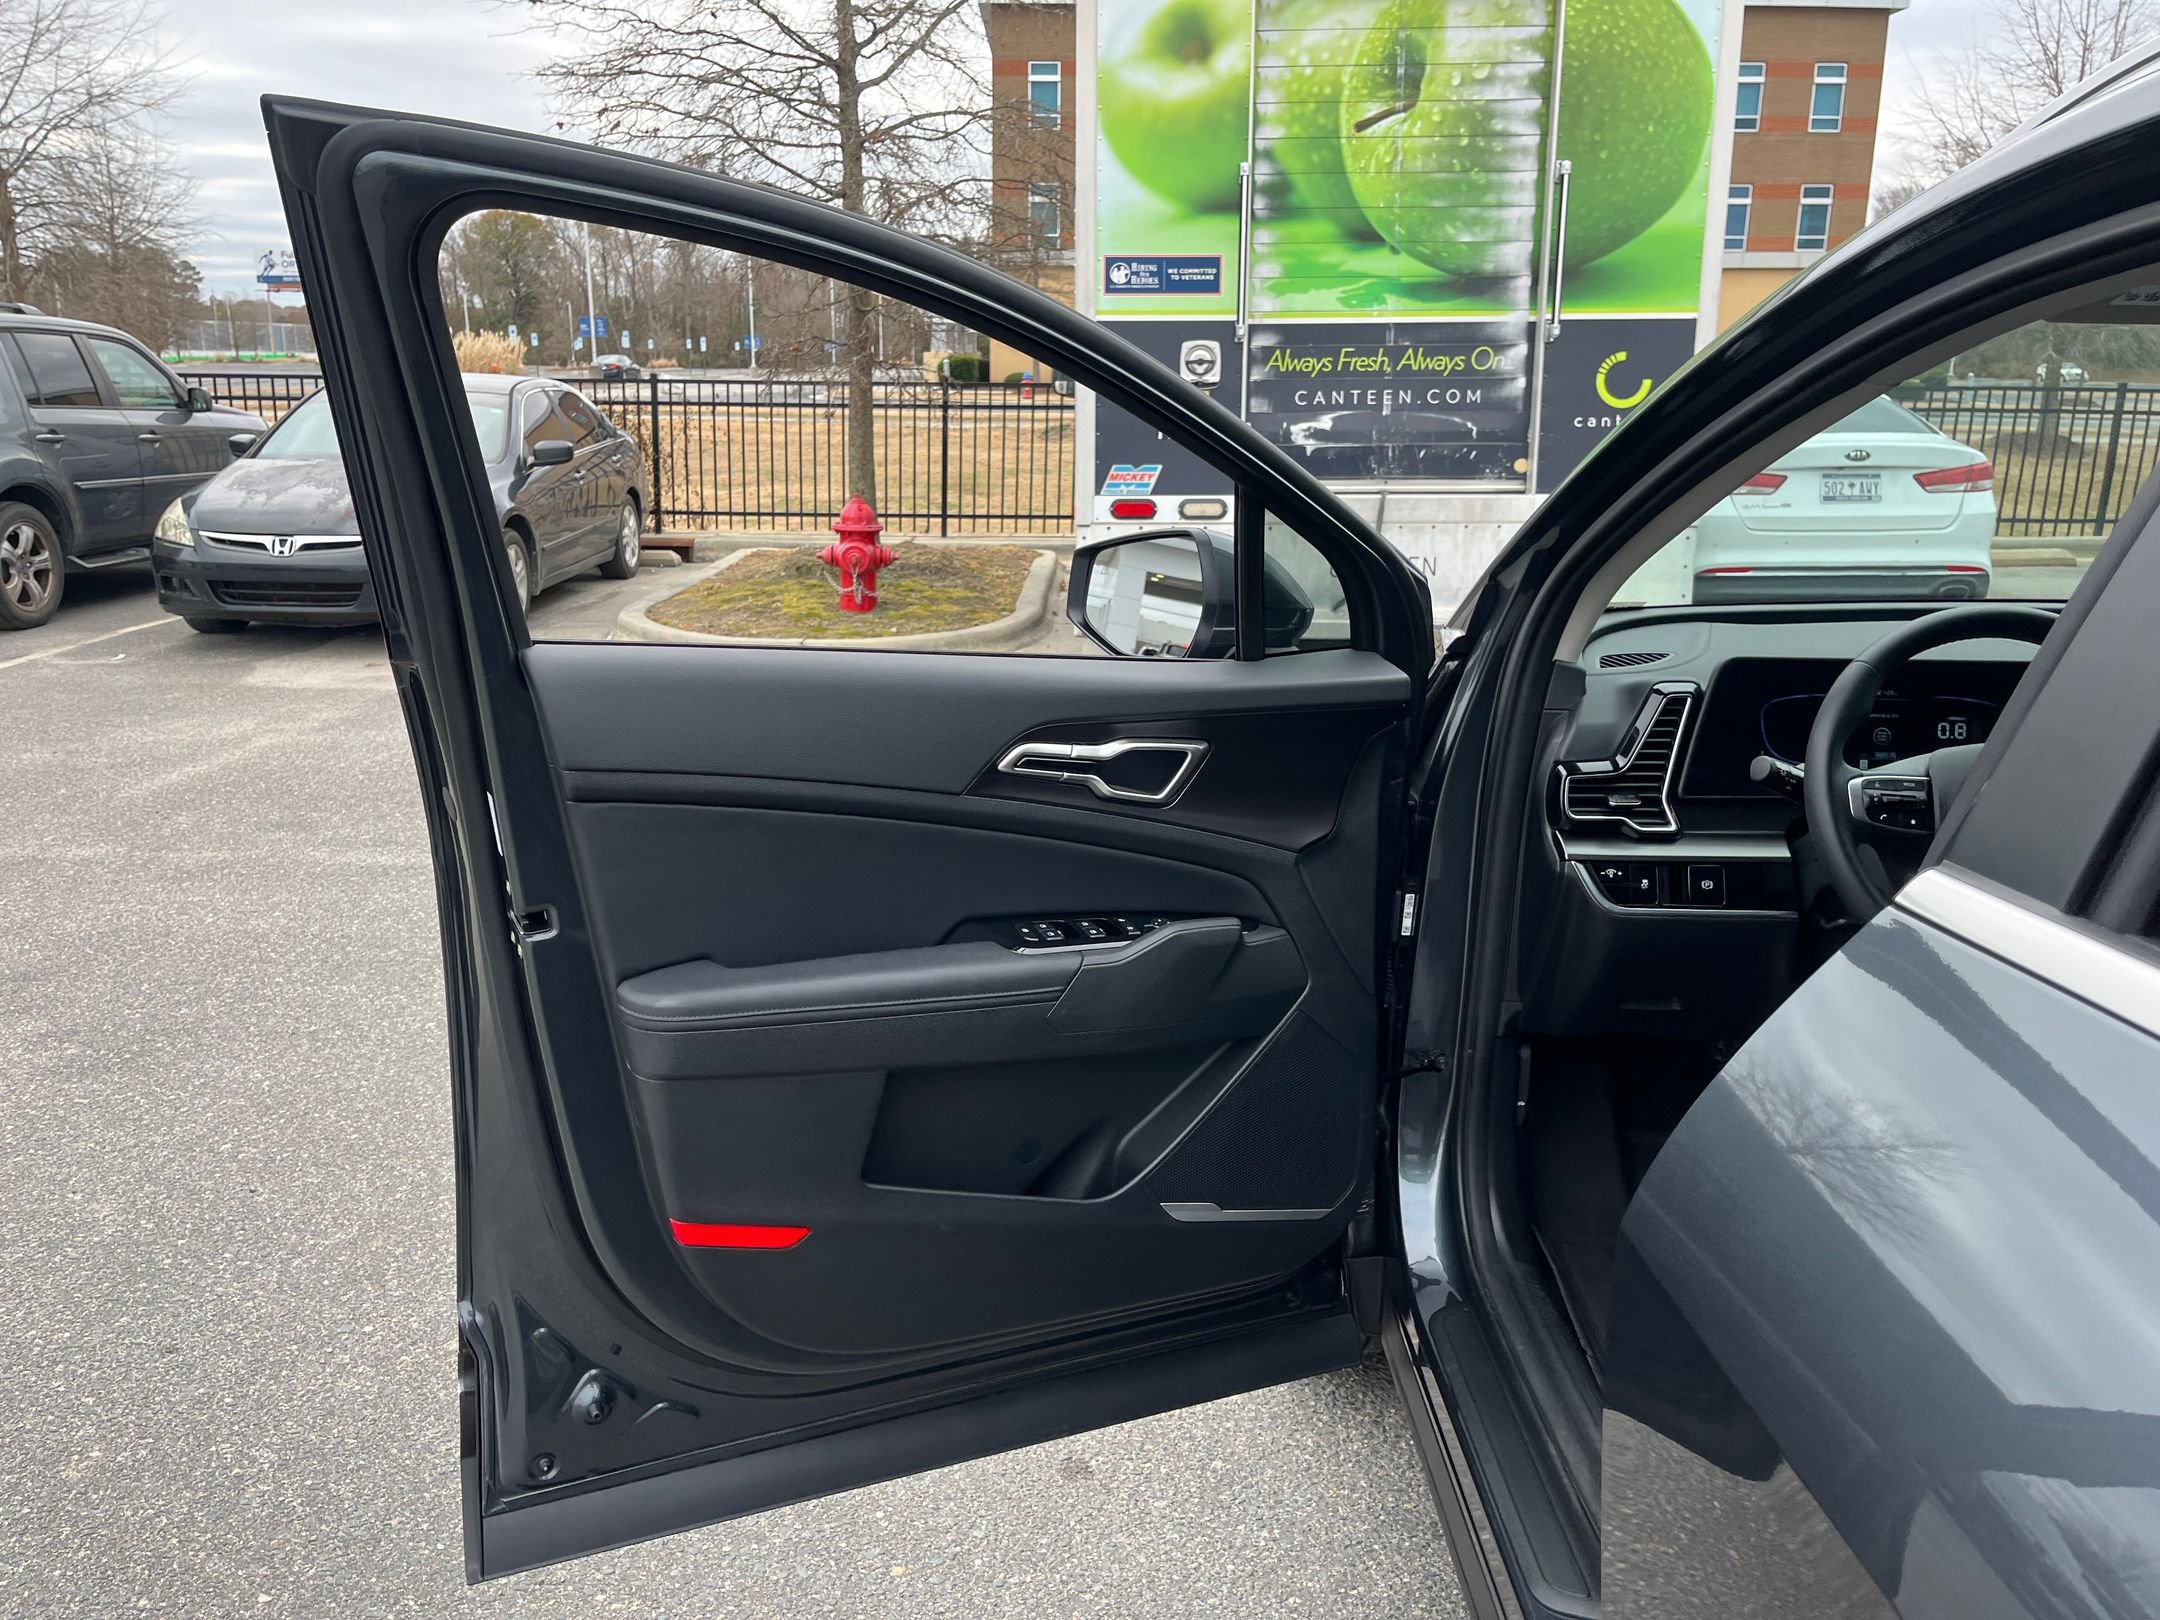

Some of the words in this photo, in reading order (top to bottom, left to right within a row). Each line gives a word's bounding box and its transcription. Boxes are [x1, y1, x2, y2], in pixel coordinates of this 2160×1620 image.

[1264, 349, 1332, 378] Always
[1337, 347, 1393, 374] Fresh,
[1396, 348, 1466, 377] Always
[1294, 388, 1482, 406] CANTEEN.COM
[1573, 414, 1621, 428] cant
[1109, 472, 1156, 482] MICKEY
[1824, 481, 1845, 496] 502
[1937, 722, 1967, 739] 0.8
